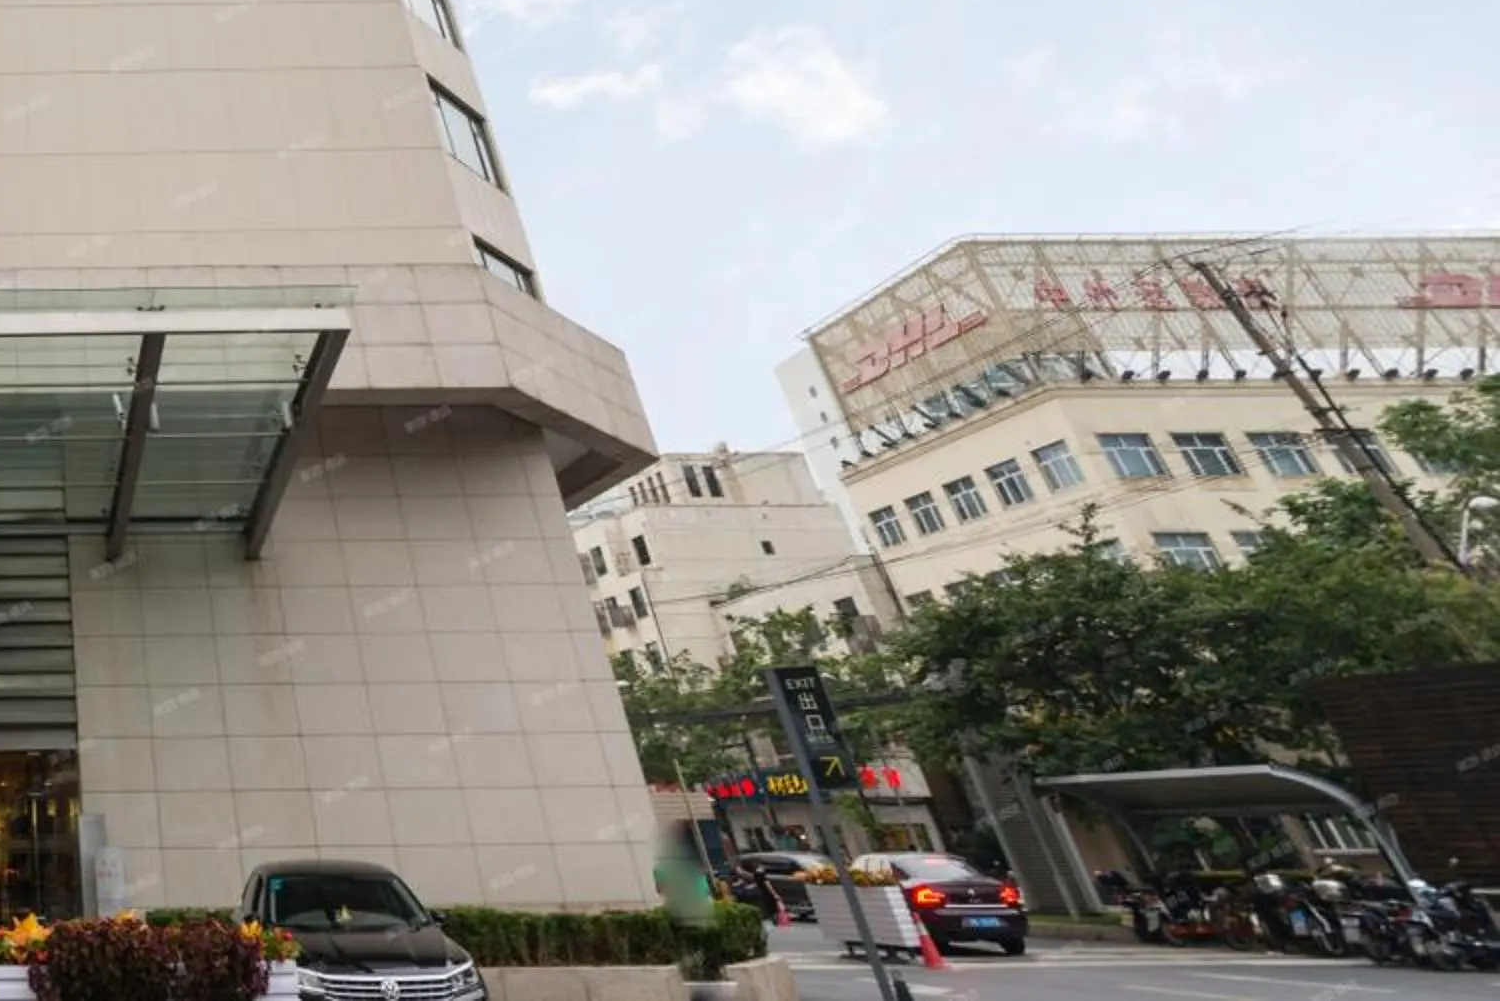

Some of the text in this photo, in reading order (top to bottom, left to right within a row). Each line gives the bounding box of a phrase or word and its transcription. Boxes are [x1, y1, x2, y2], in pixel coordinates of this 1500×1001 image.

[841, 302, 988, 394] DHL
[784, 678, 816, 690] EXIT
[797, 692, 827, 731] 出口
